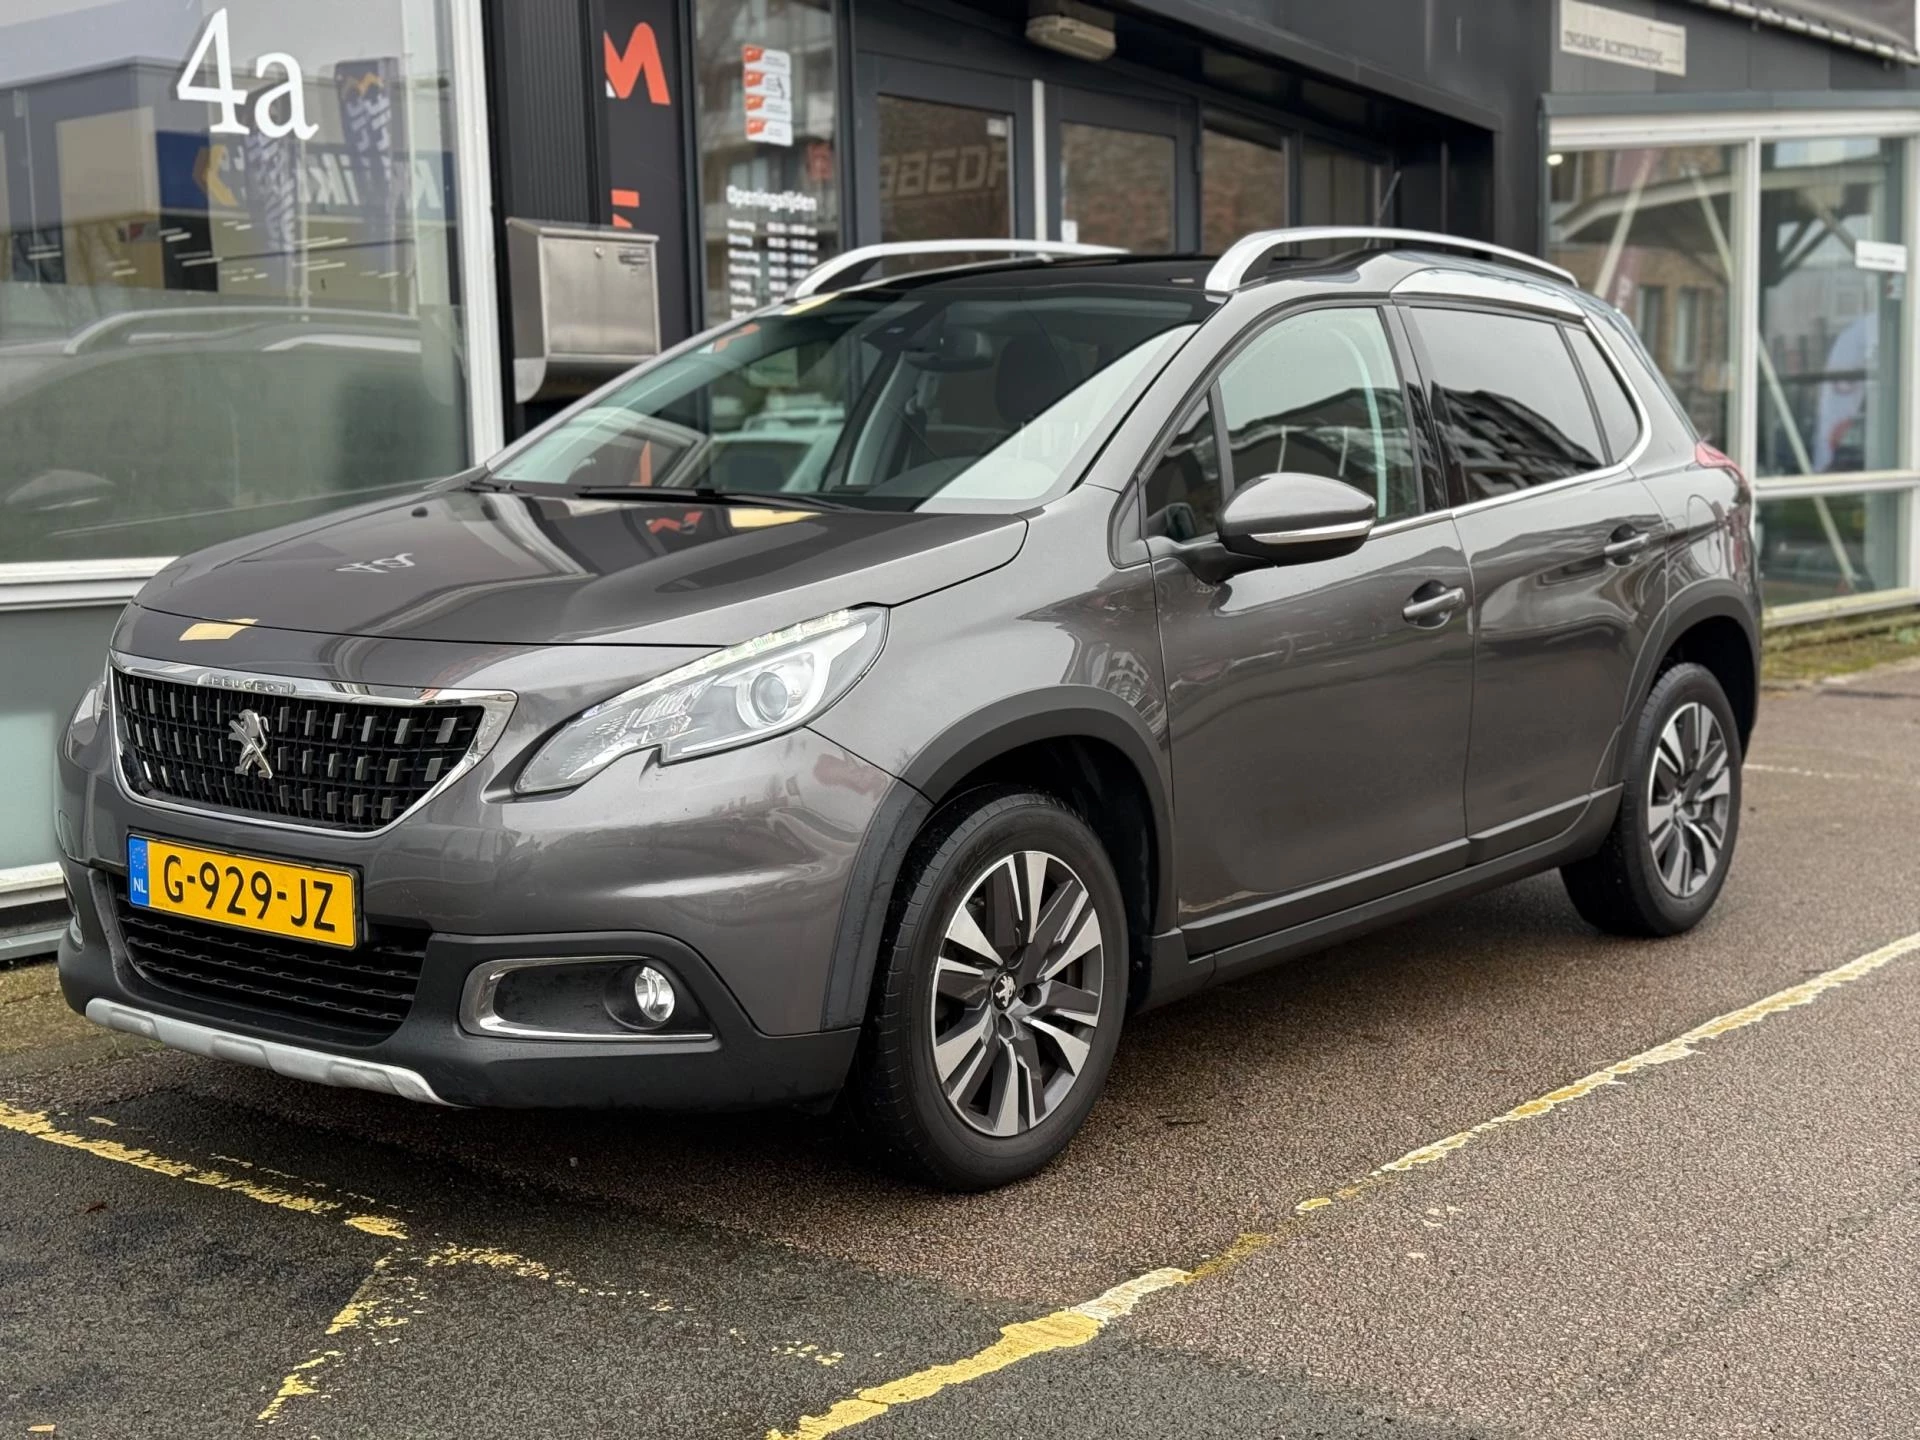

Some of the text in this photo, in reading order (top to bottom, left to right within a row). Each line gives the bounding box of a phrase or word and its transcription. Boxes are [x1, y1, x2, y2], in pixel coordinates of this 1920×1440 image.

[176, 8, 319, 140] 4a
[211, 675, 288, 695] PEUGEOT
[133, 877, 147, 894] NL
[163, 854, 336, 933] G-929-JZ
